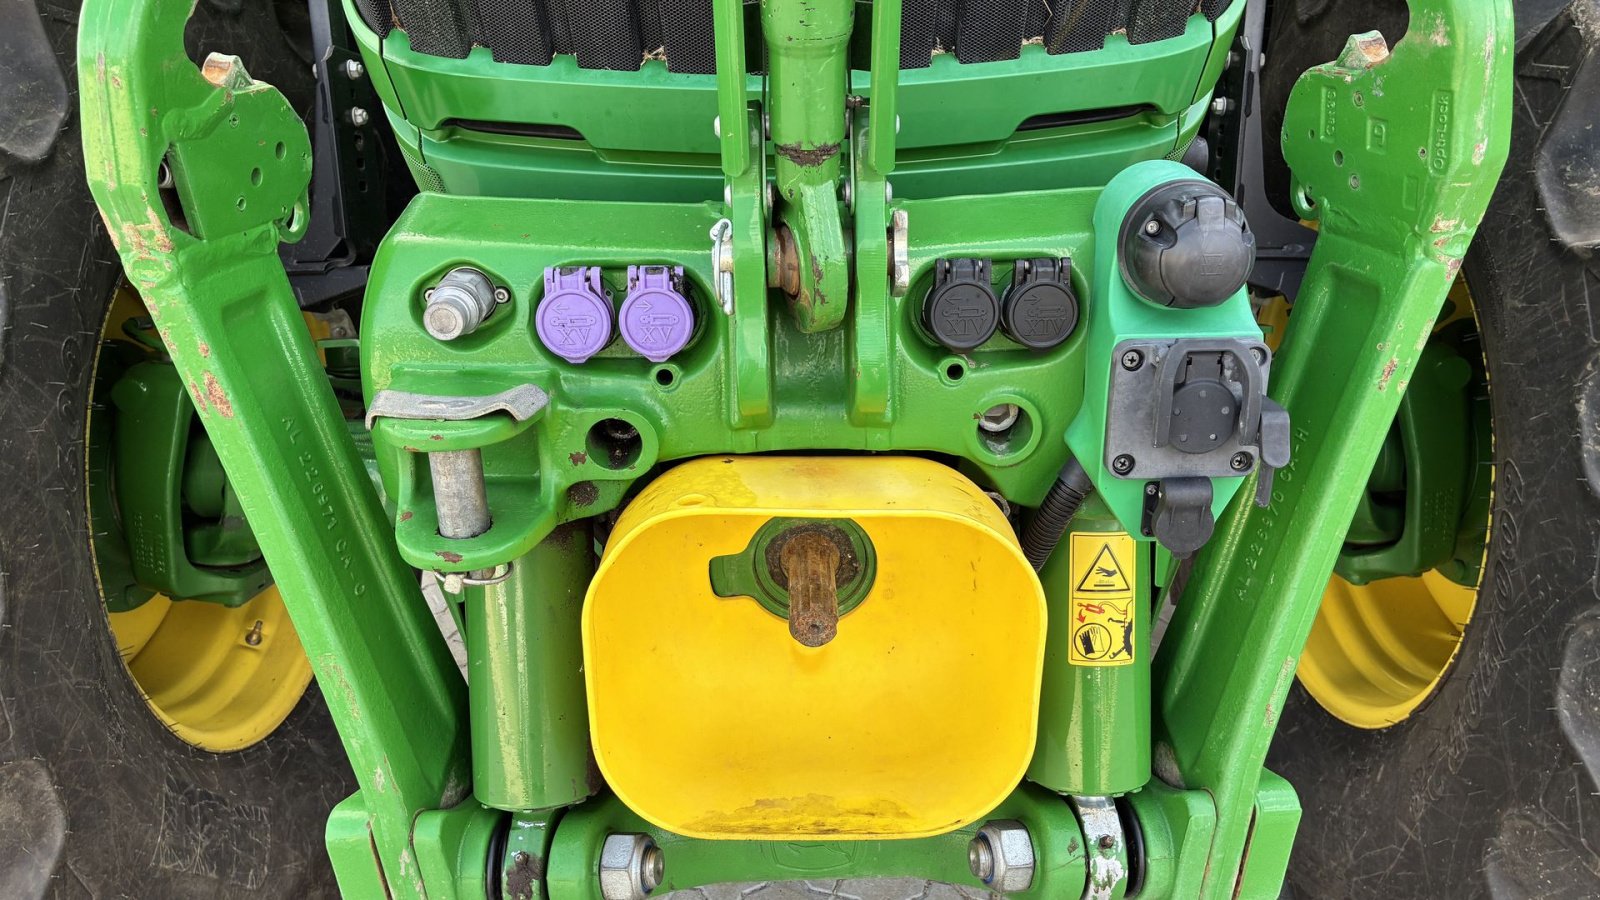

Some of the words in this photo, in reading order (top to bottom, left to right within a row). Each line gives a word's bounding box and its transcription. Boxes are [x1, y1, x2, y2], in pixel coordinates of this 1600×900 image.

[1433, 96, 1449, 170] Opti-Lock
[557, 327, 592, 346] XV
[640, 326, 672, 344] XV
[282, 415, 301, 445] AL
